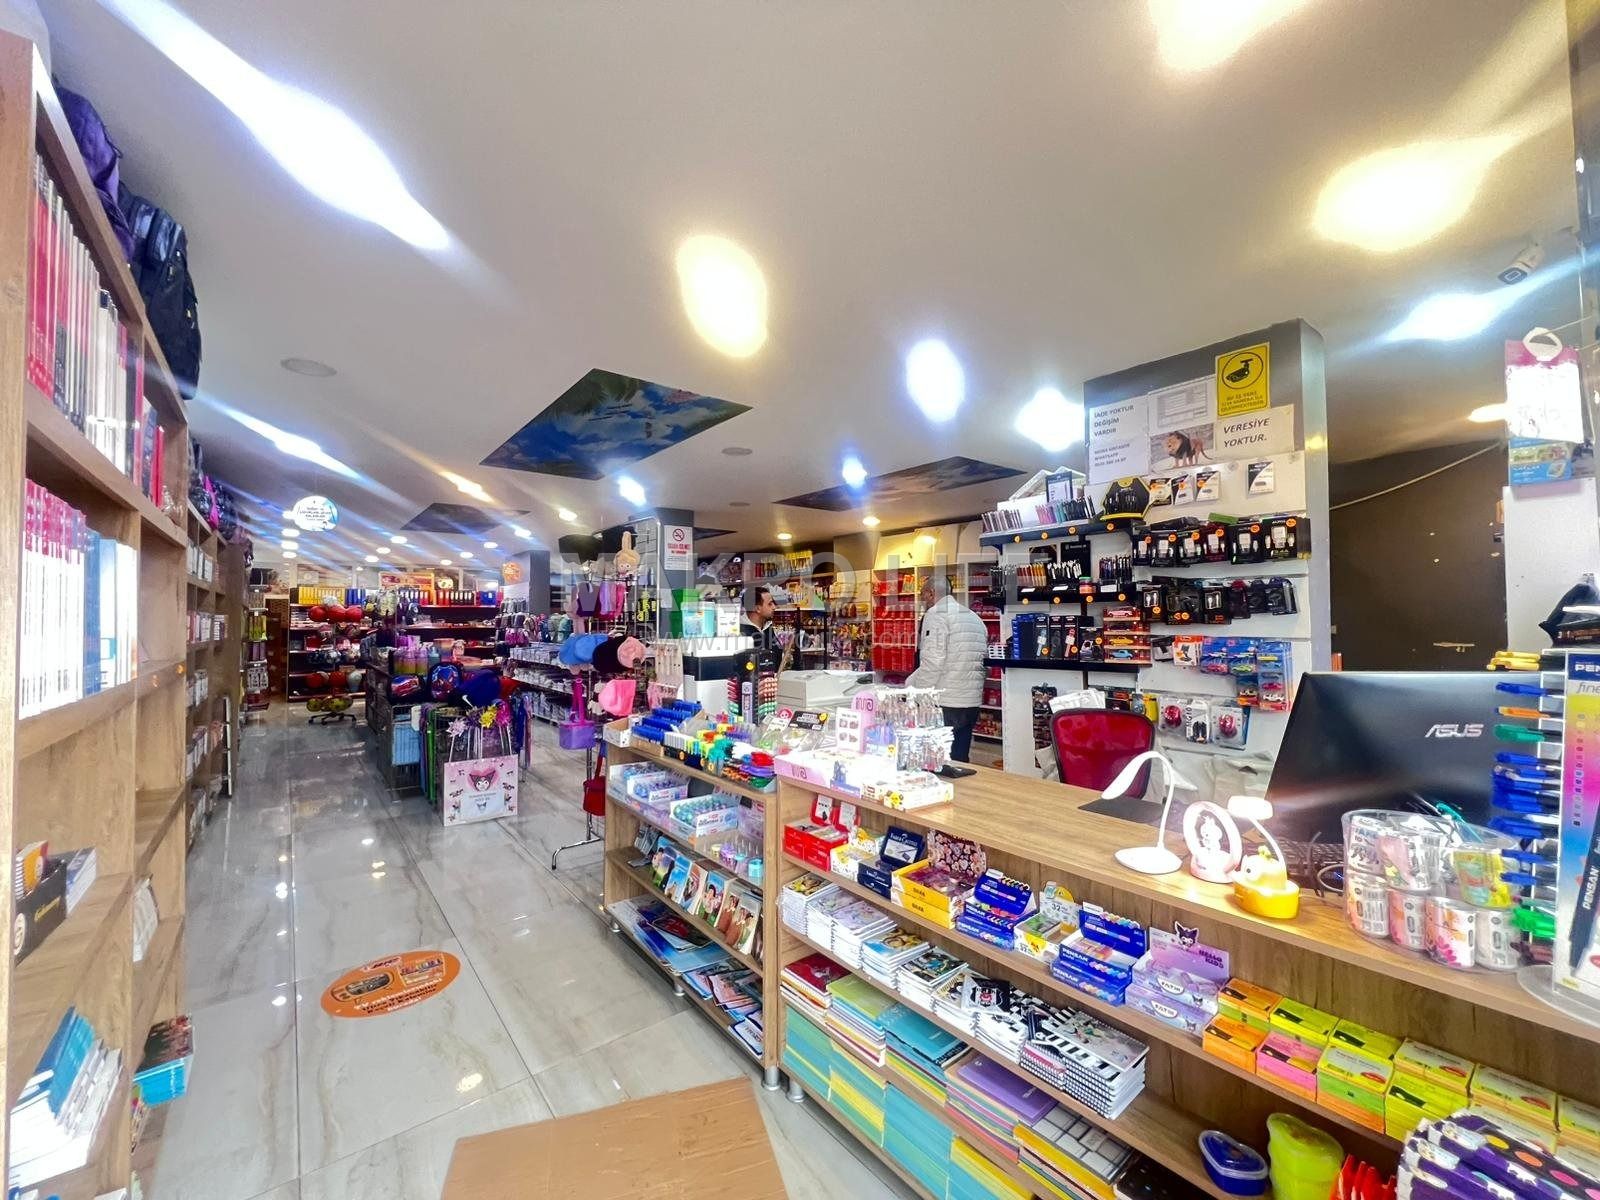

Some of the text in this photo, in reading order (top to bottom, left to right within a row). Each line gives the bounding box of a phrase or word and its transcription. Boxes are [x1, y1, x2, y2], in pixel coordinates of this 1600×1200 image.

[1110, 405, 1134, 415] YOKTUR
[1223, 417, 1271, 434] VERESİYE
[1224, 434, 1268, 448] YOKTUR.
[1424, 723, 1485, 738] ASUS
[1582, 865, 1599, 911] PENSAN
[1062, 947, 1089, 962] PENSAN
[1199, 949, 1223, 963] HELLO
